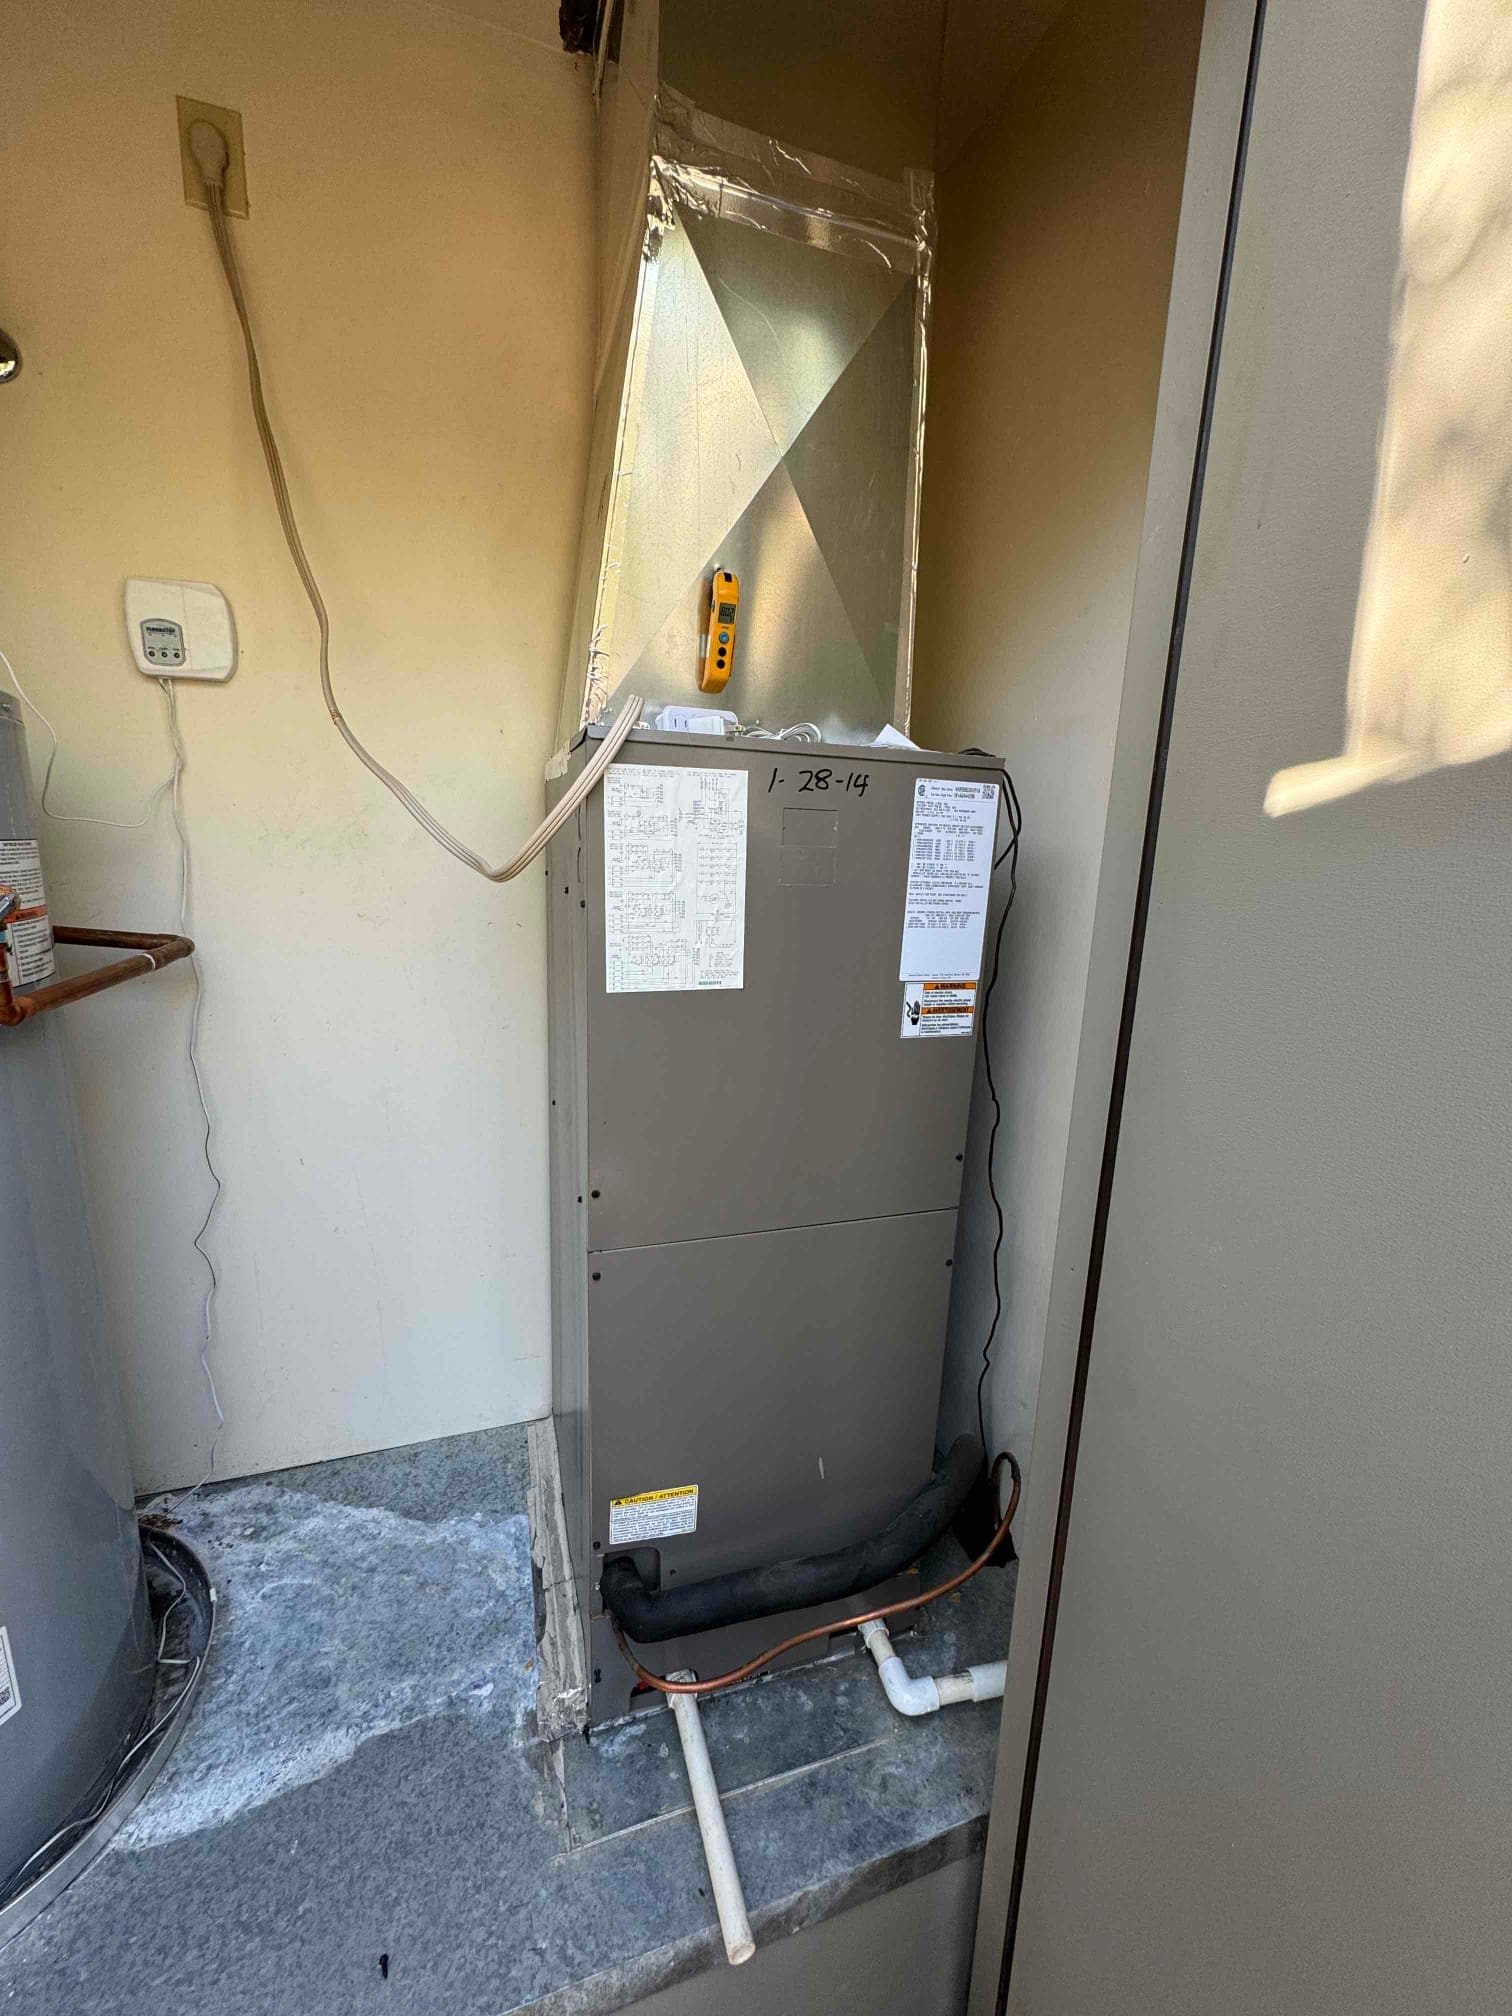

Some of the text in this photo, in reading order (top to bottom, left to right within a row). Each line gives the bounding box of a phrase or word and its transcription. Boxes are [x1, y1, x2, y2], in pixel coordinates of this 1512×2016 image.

[798, 768, 870, 797] 28-14
[624, 1495, 654, 1504] CAUTION
[659, 1488, 694, 1499] ATTENTION
